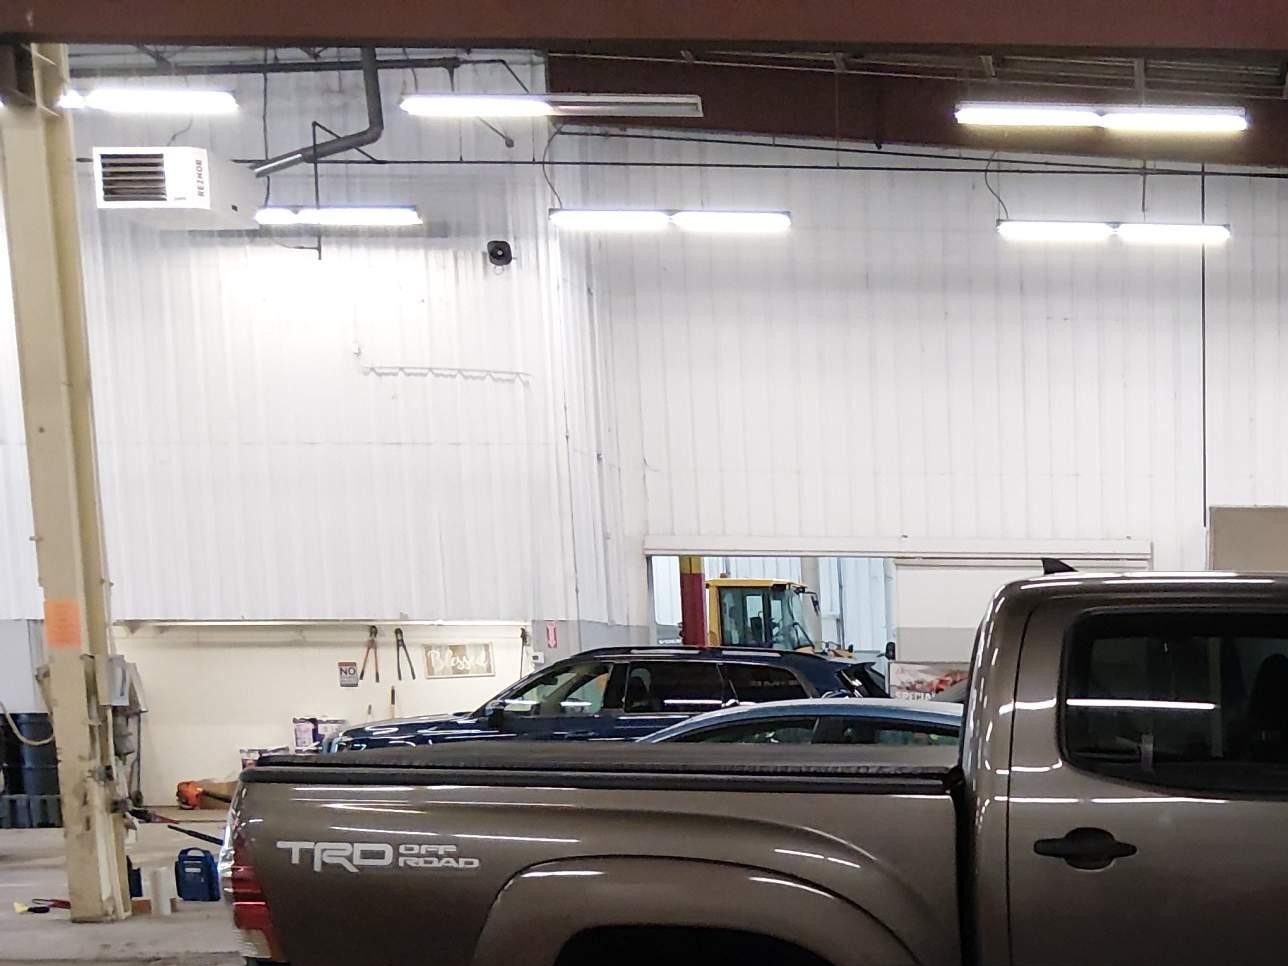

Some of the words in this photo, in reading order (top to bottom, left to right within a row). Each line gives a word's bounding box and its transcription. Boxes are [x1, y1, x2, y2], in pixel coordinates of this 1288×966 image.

[340, 667, 356, 676] NO
[399, 845, 456, 855] OFF
[276, 841, 393, 872] TRD
[399, 857, 479, 868] ROAD
